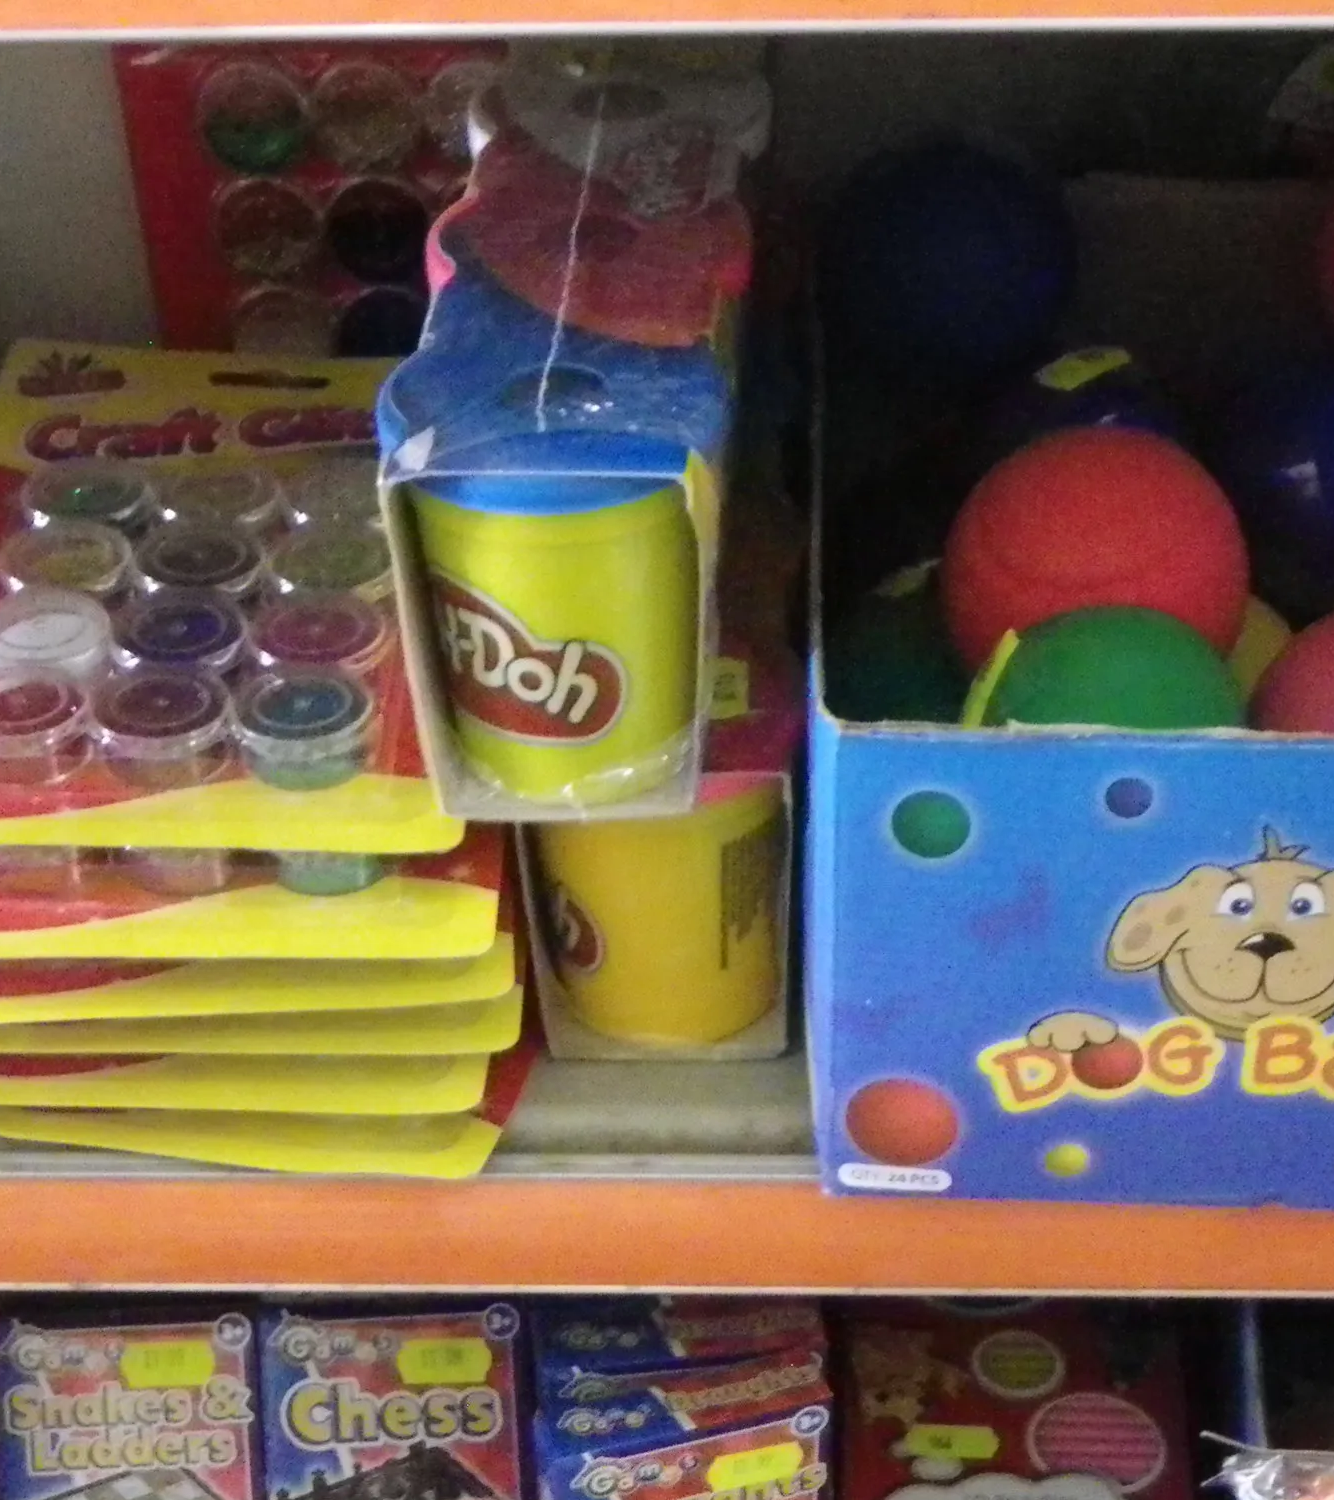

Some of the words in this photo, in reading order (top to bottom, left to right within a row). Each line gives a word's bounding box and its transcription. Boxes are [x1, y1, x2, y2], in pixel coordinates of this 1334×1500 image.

[991, 1022, 1215, 1106] DOG
[8, 1381, 191, 1432] Snakes
[200, 1374, 251, 1422] &
[285, 1378, 499, 1446] Chess
[30, 1424, 237, 1472] Ladders
